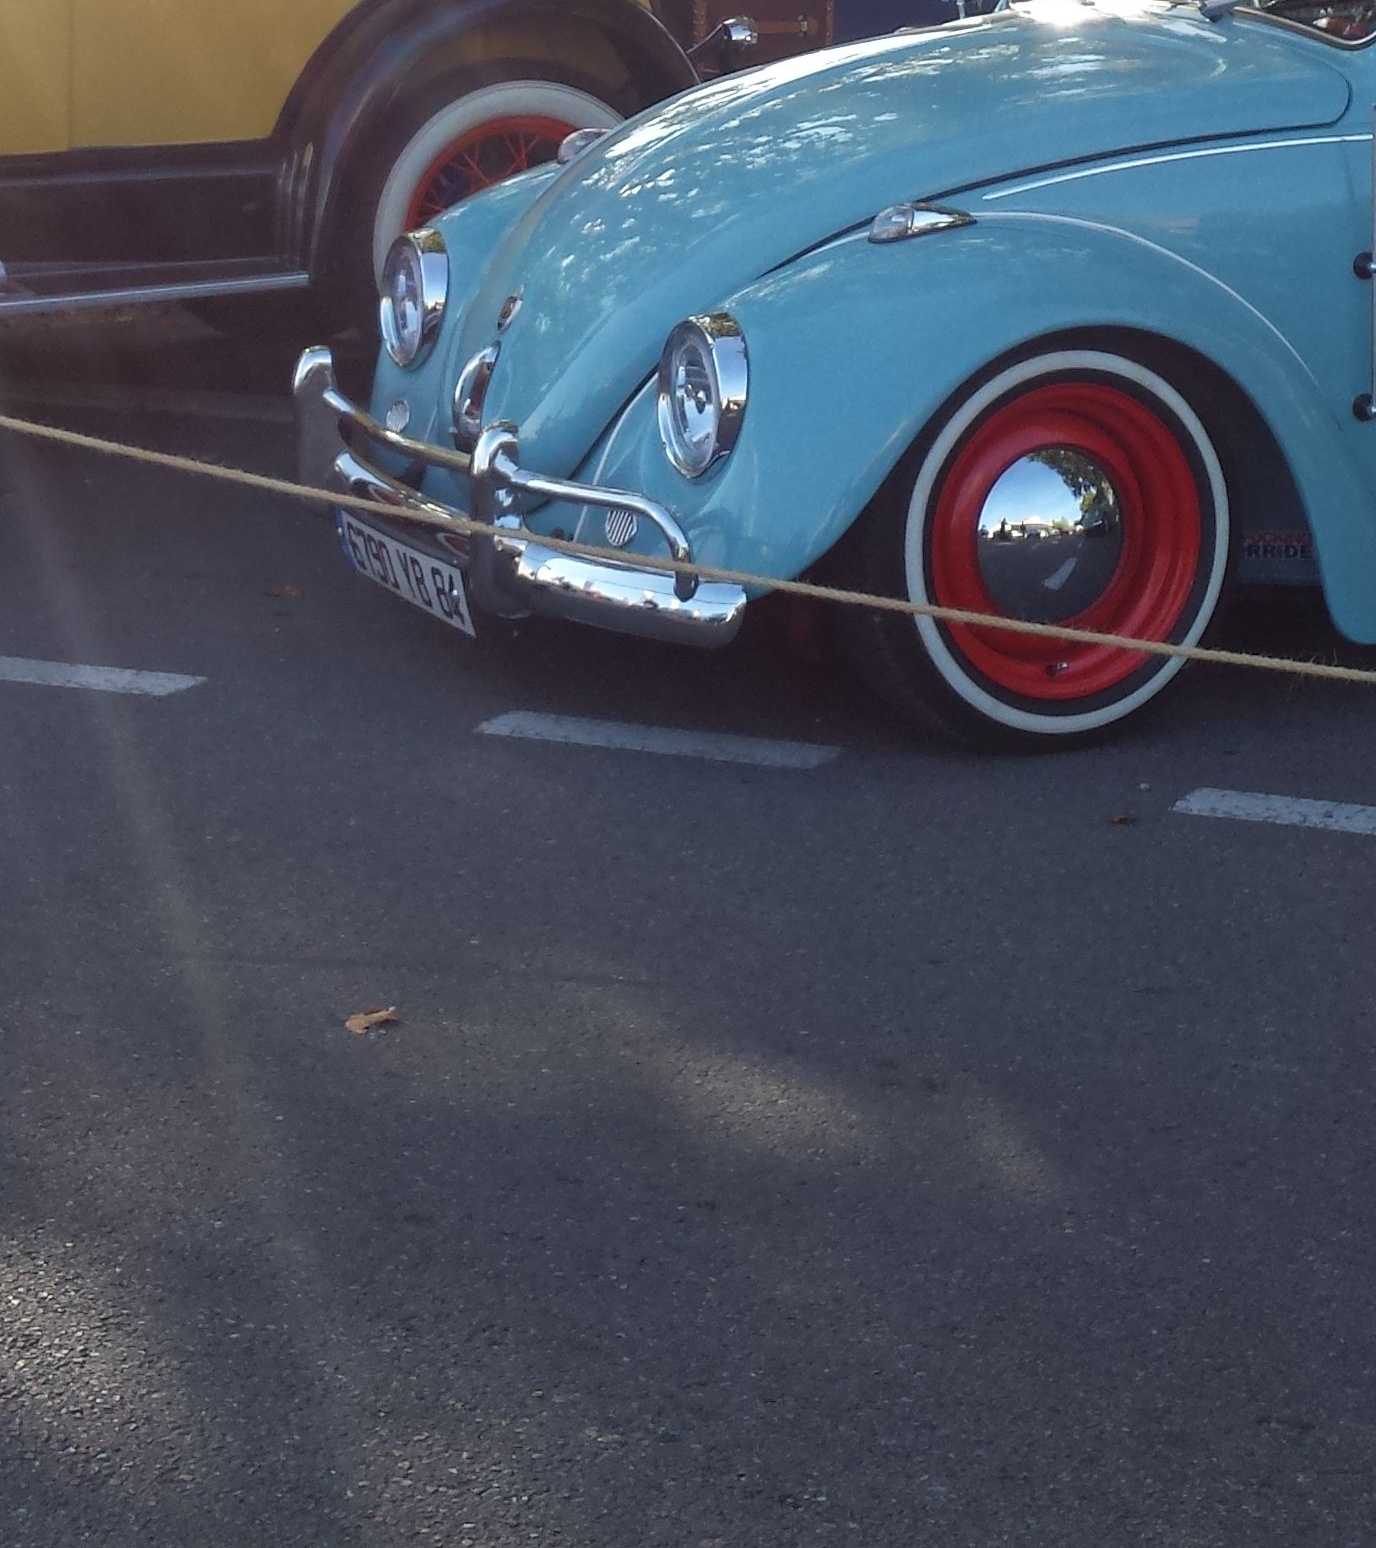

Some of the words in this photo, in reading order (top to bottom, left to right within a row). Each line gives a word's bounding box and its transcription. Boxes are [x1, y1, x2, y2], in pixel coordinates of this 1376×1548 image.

[347, 521, 401, 591] 6790
[398, 549, 431, 606] YB
[433, 567, 465, 625] 84
